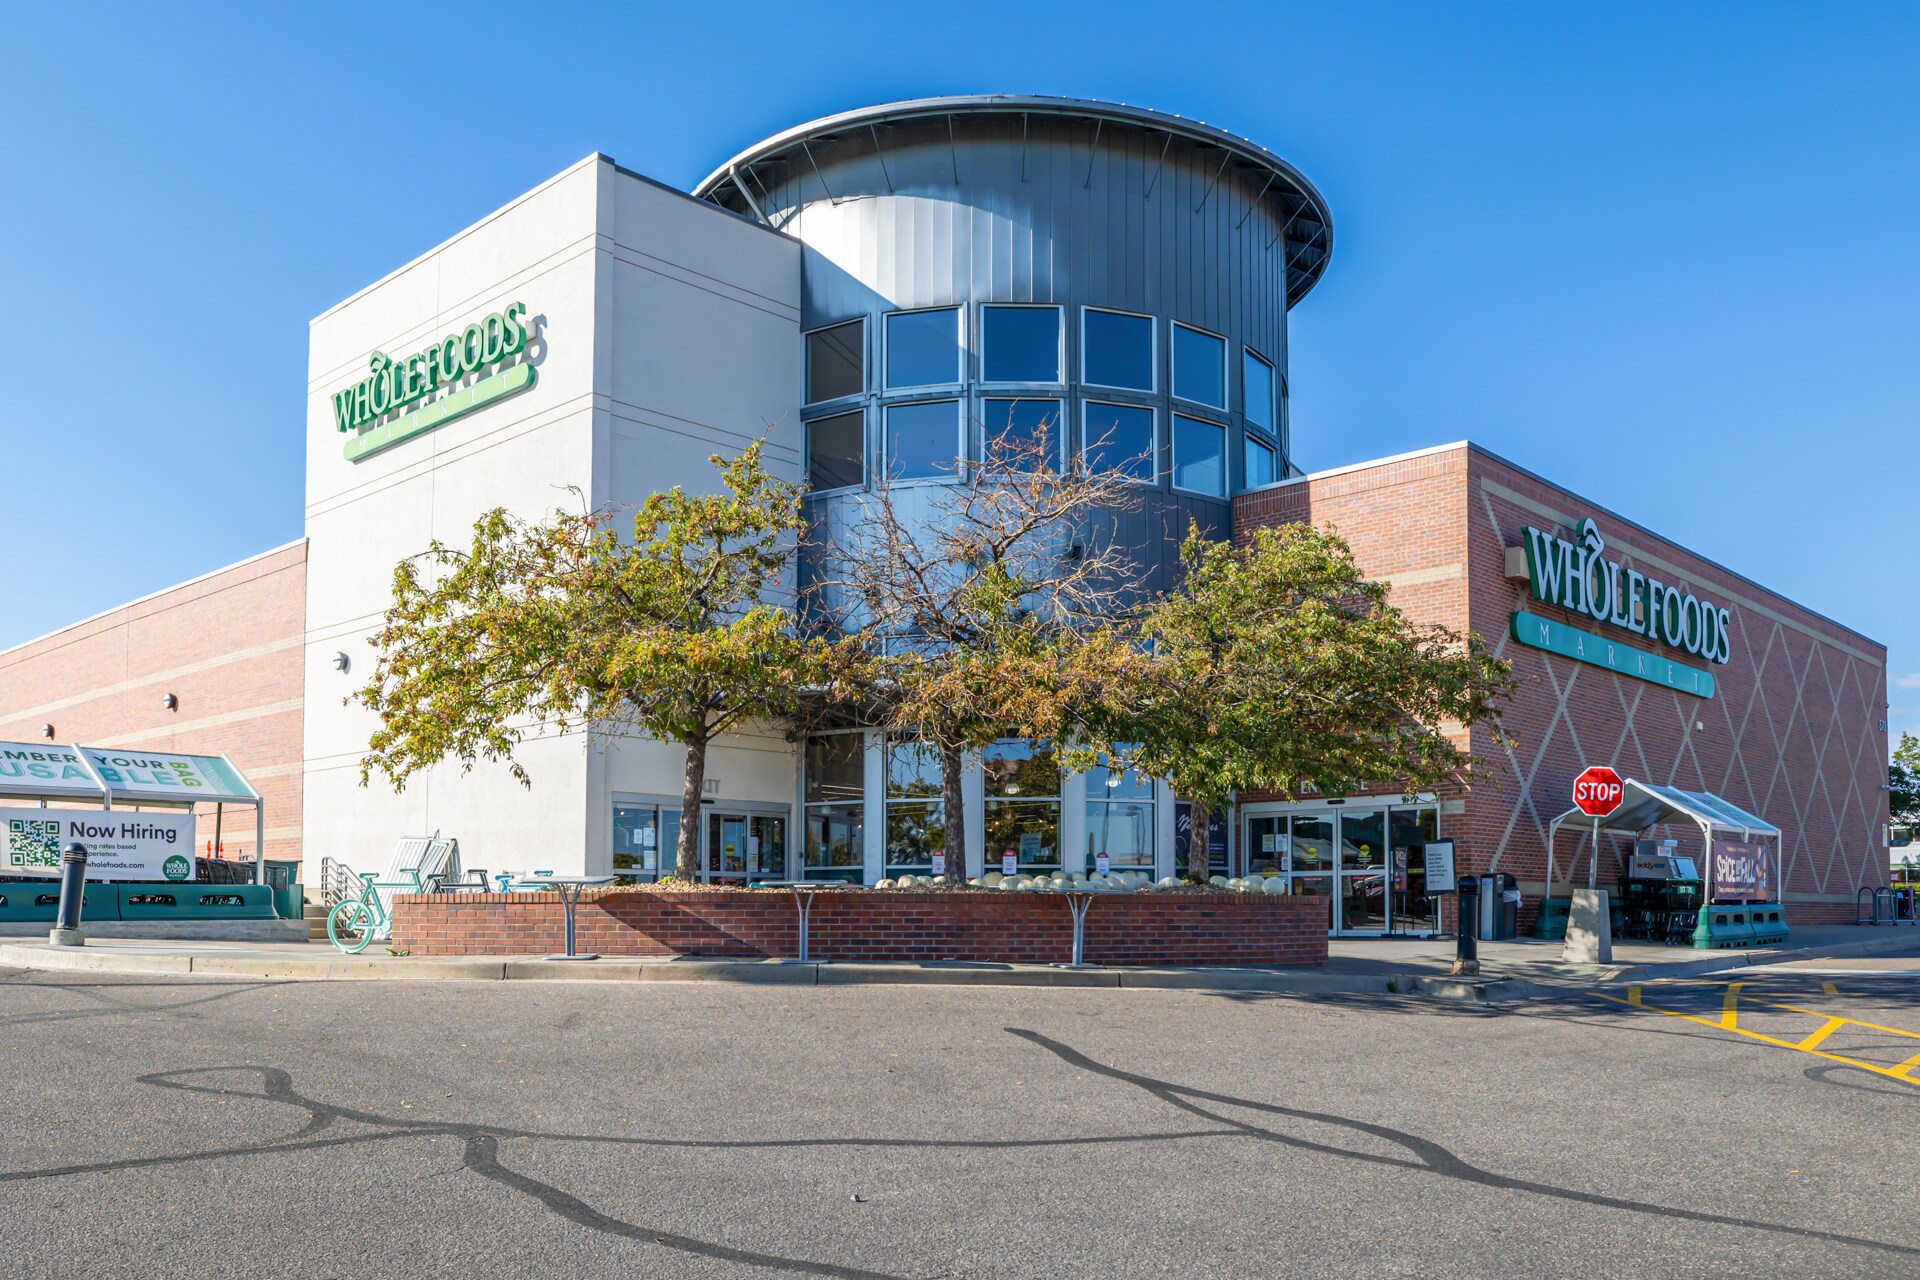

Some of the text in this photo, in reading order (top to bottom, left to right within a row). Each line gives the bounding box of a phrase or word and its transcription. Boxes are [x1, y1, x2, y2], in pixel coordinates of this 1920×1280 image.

[331, 301, 526, 433] WHOLE FOODS
[358, 374, 510, 451] MARKET
[1521, 517, 1730, 664] WHOLE FOODS
[1539, 621, 1699, 691] MARKET
[0, 750, 165, 769] MBER YOUR
[168, 762, 202, 787] BAG
[1576, 781, 1620, 801] STOP
[70, 821, 176, 843] Now Hiring
[165, 860, 188, 869] WHOLE
